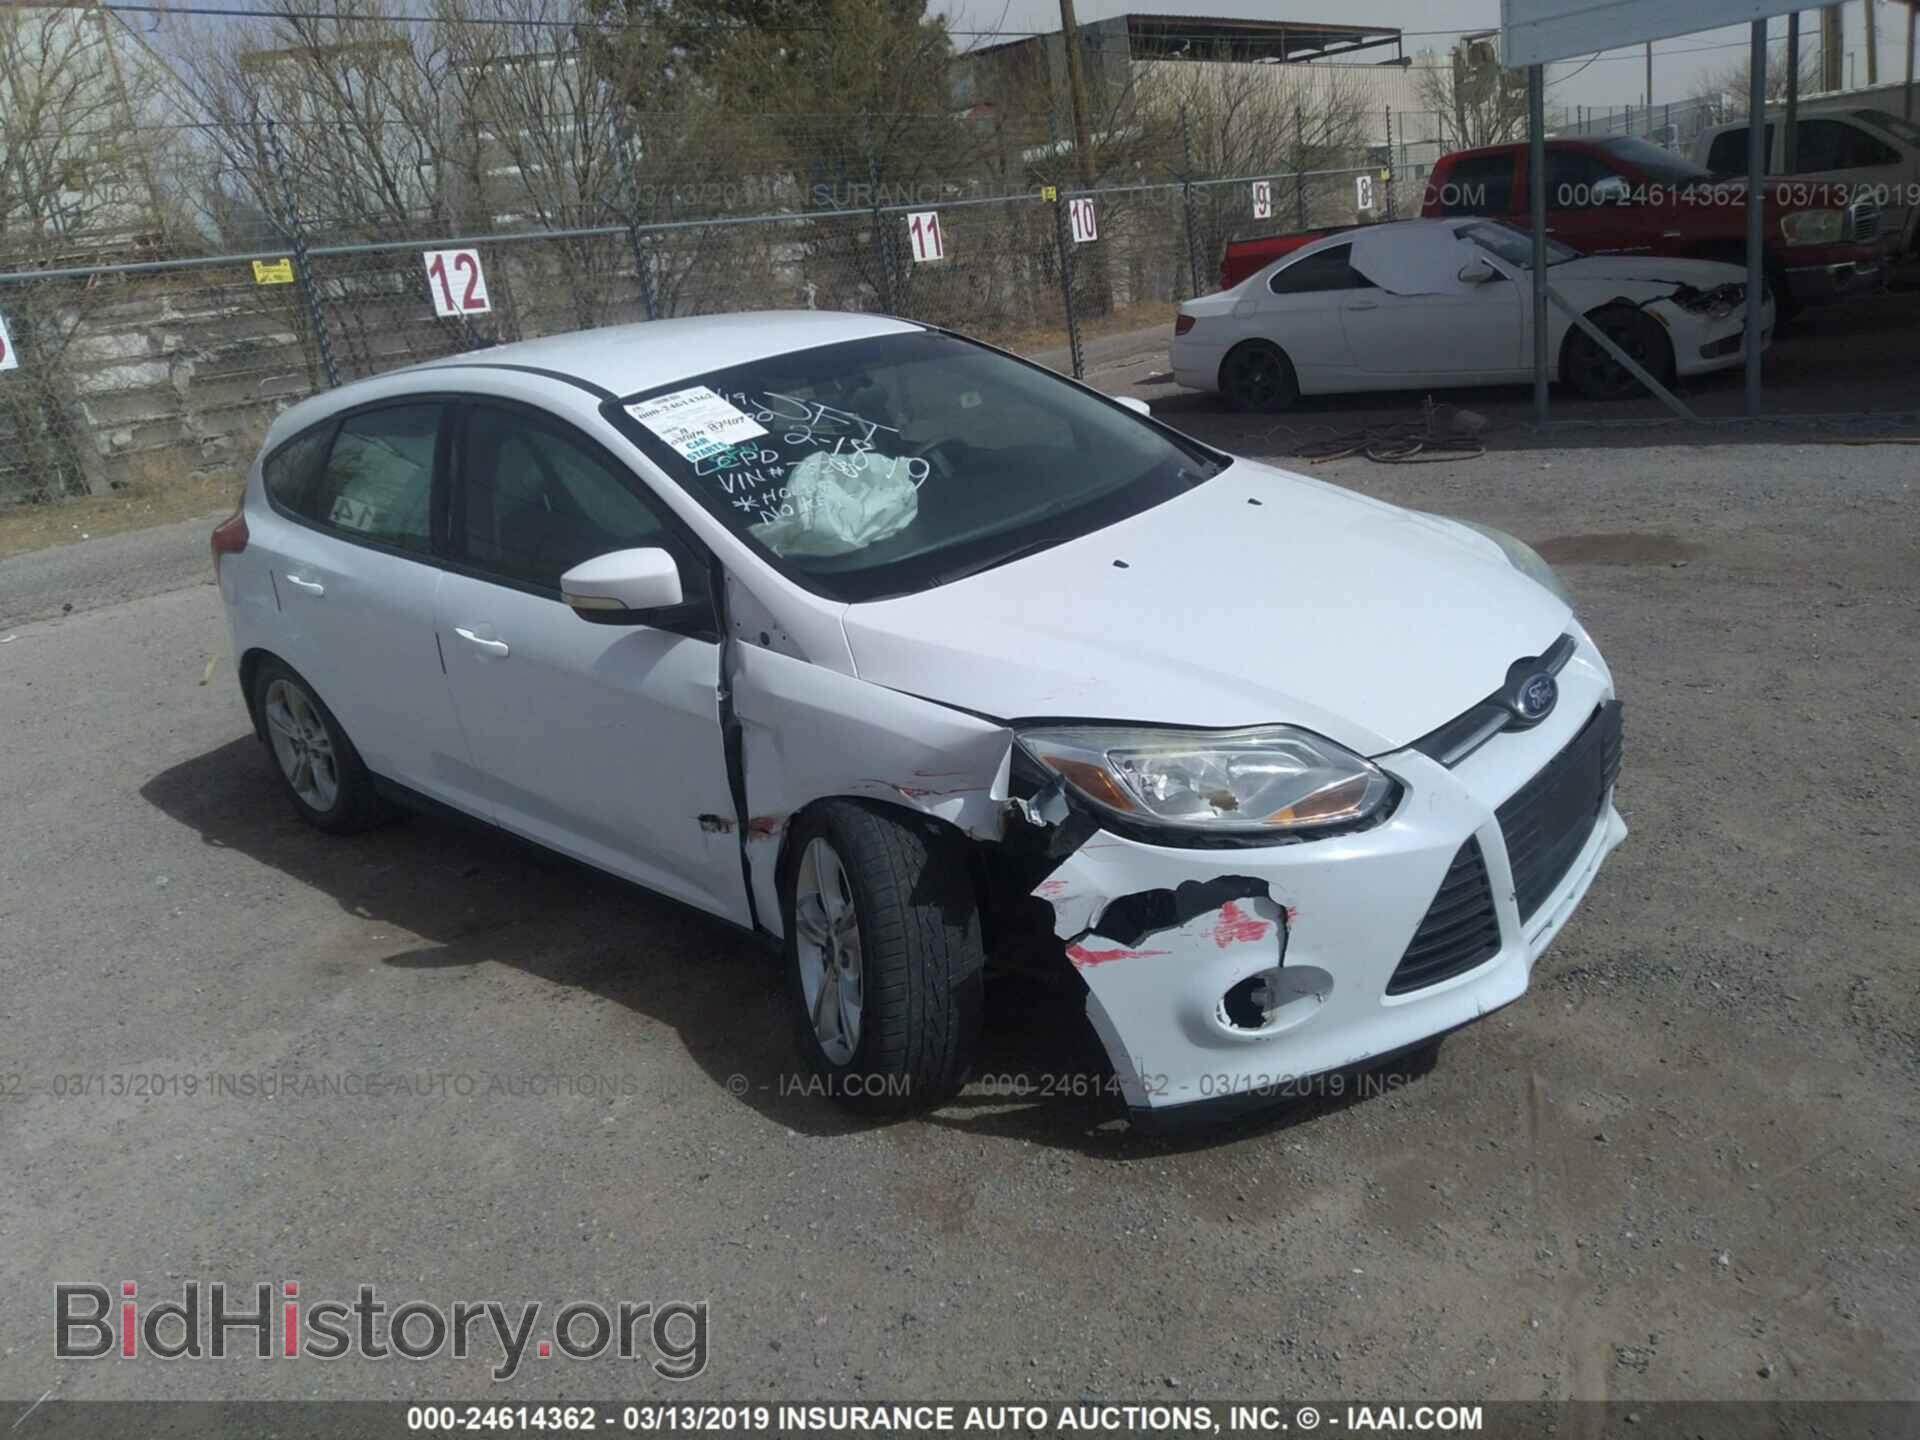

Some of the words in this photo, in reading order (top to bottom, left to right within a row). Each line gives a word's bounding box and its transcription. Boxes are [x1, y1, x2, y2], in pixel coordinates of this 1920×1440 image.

[1258, 184, 1267, 216] 9
[1361, 178, 1369, 207] 8
[911, 215, 942, 258] 11
[1072, 200, 1095, 239] 10
[430, 252, 487, 312] 12
